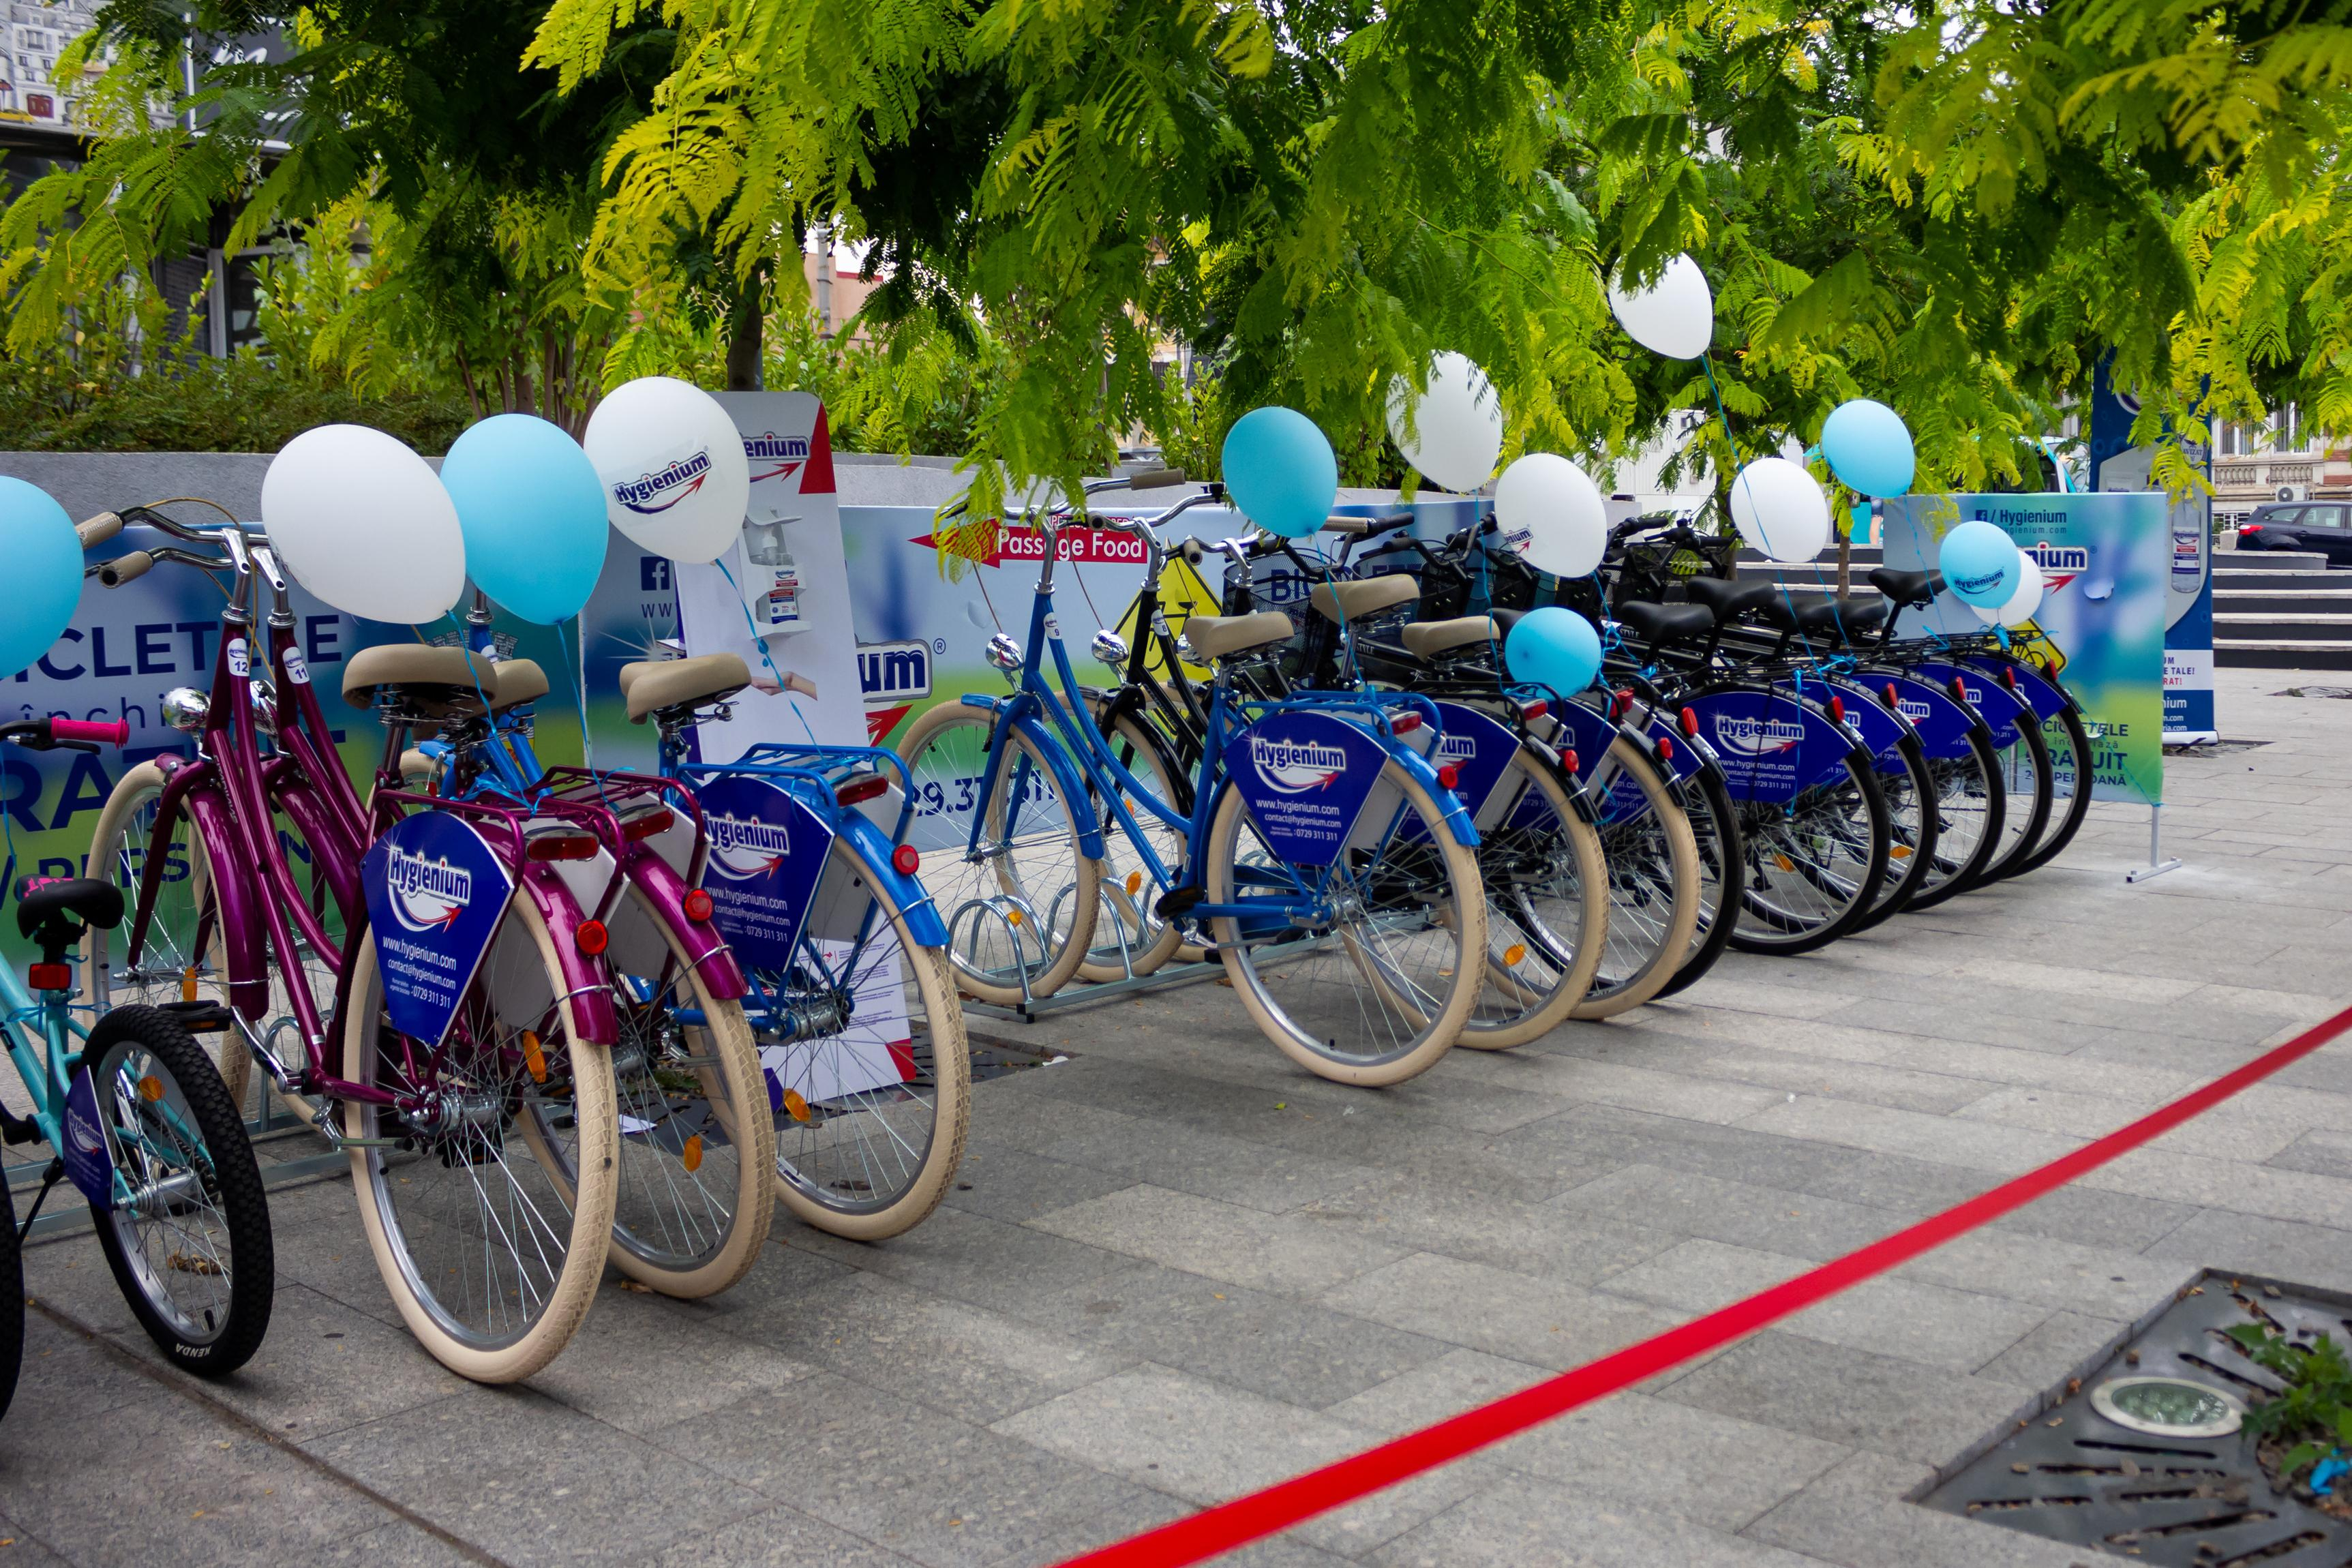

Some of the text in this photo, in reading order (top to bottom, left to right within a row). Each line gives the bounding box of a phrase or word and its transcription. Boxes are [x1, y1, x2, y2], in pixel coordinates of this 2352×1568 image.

[614, 454, 710, 502] Hygienium
[2000, 509, 2067, 526] Hygienium
[1092, 532, 1142, 558] Food
[1954, 570, 2004, 589] Hygienium
[234, 661, 248, 673] 12
[295, 667, 307, 679] 11
[2171, 667, 2195, 675] TALE!
[1718, 718, 1803, 739] Hygienium
[1254, 740, 1345, 768] Hygienium
[1256, 799, 1340, 815] www.hygienium.com
[1264, 813, 1342, 828] contact@hygienium.com
[1313, 829, 1325, 840] 311
[1326, 831, 1338, 841] 311
[390, 847, 470, 901] Hygienium
[714, 904, 791, 926] contact@hygienium.com
[764, 926, 775, 939] 311
[777, 929, 787, 943] 311
[382, 936, 457, 971] www.hygienium.com
[388, 958, 456, 991] contact@hygienium.com
[428, 990, 439, 1006] 311
[440, 994, 451, 1009] 311
